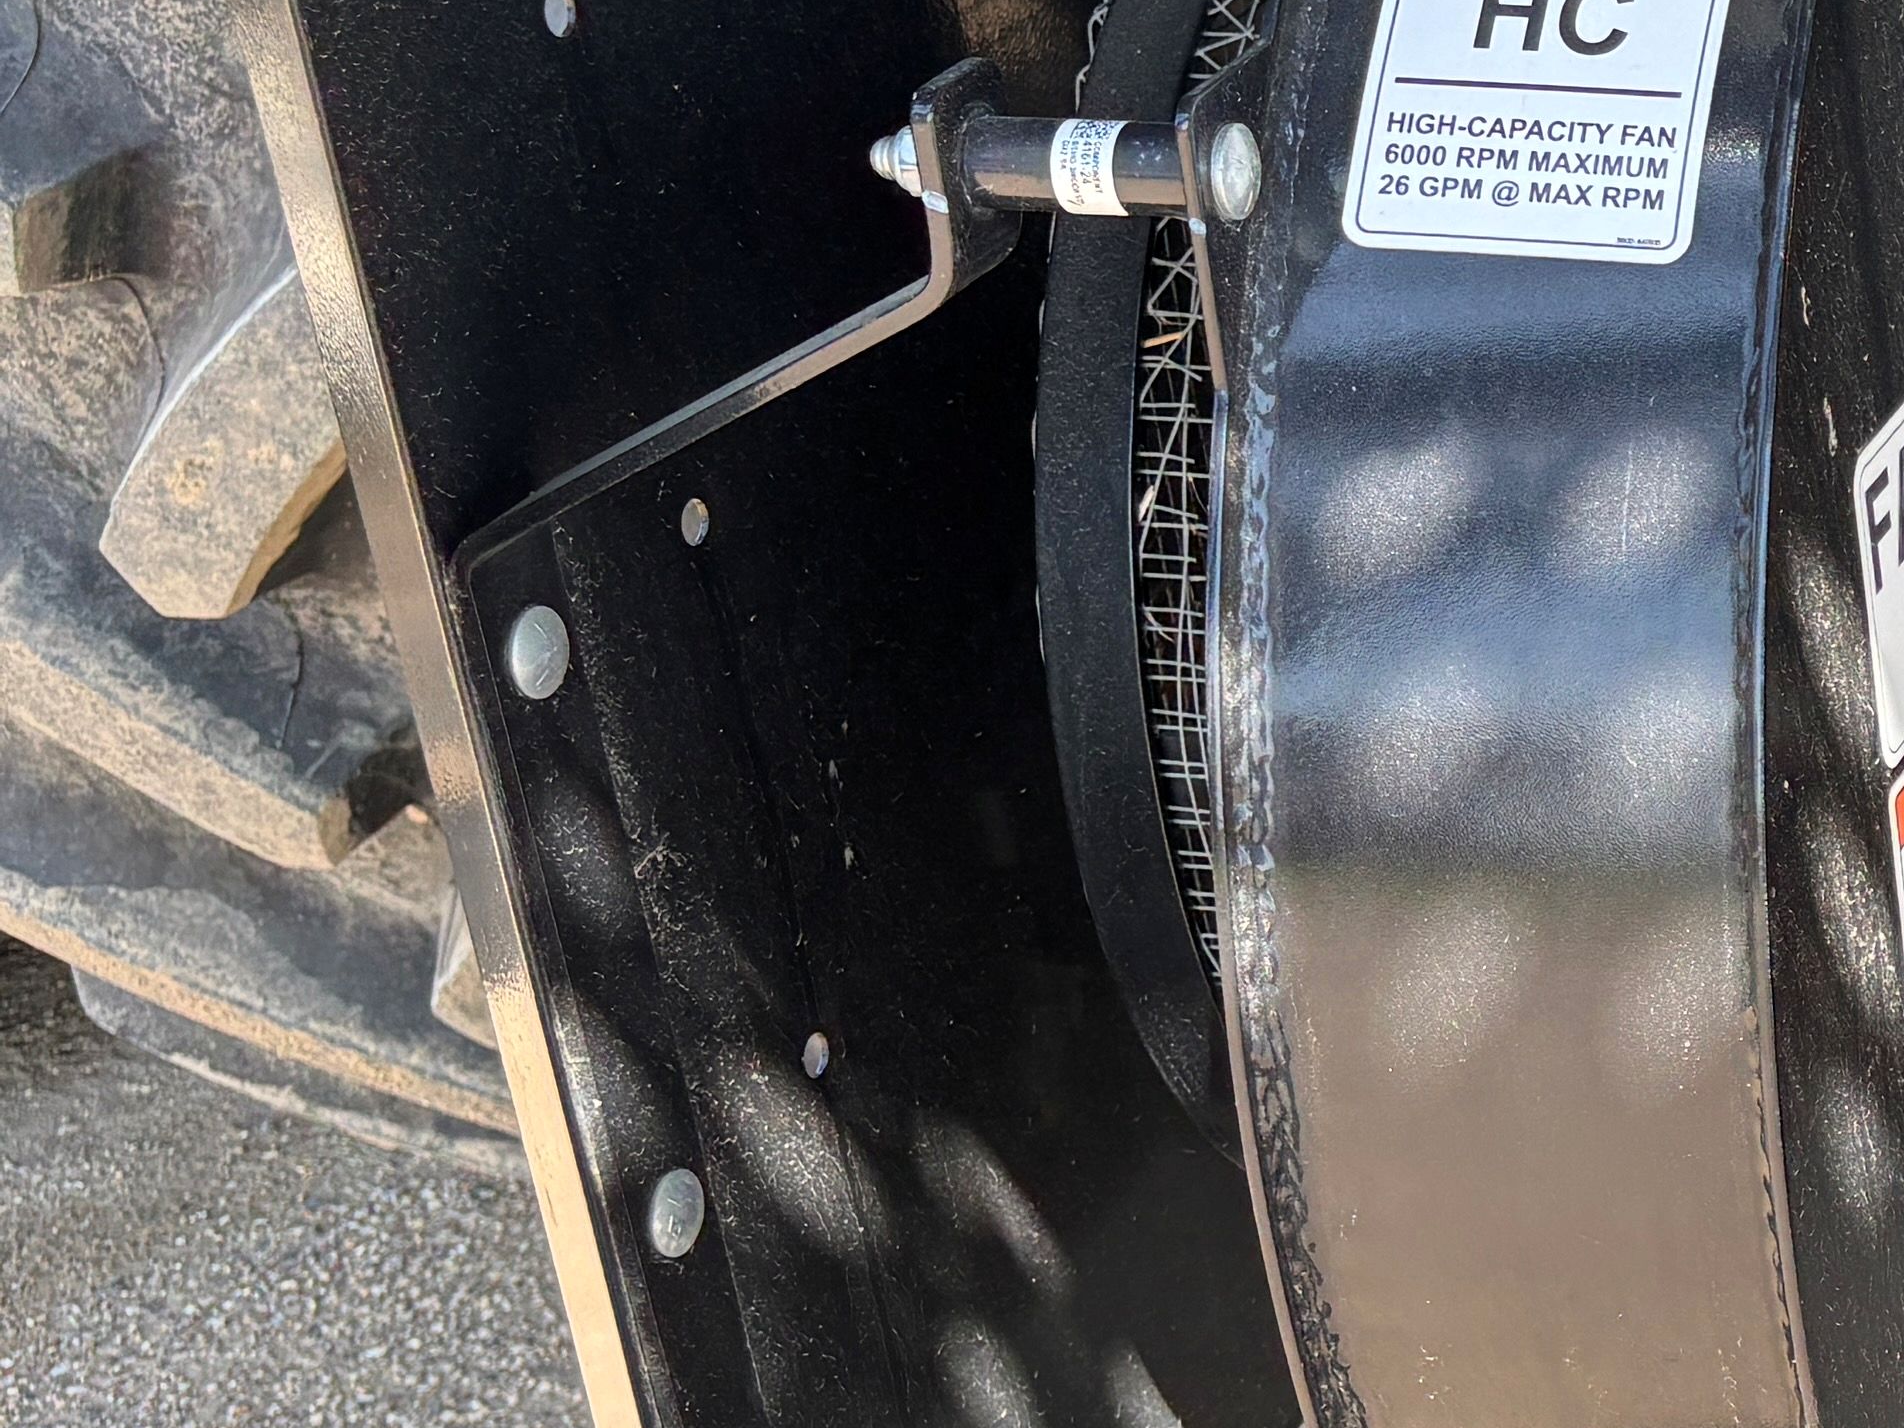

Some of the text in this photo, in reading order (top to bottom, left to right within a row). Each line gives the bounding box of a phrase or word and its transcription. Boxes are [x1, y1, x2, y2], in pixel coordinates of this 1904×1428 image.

[1386, 112, 1677, 149] HIGH-CAPACITY FAN
[1384, 143, 1669, 180] 6000 RPM MAXIMUM
[1378, 174, 1665, 212] 26 GPM @ MAX RPM
